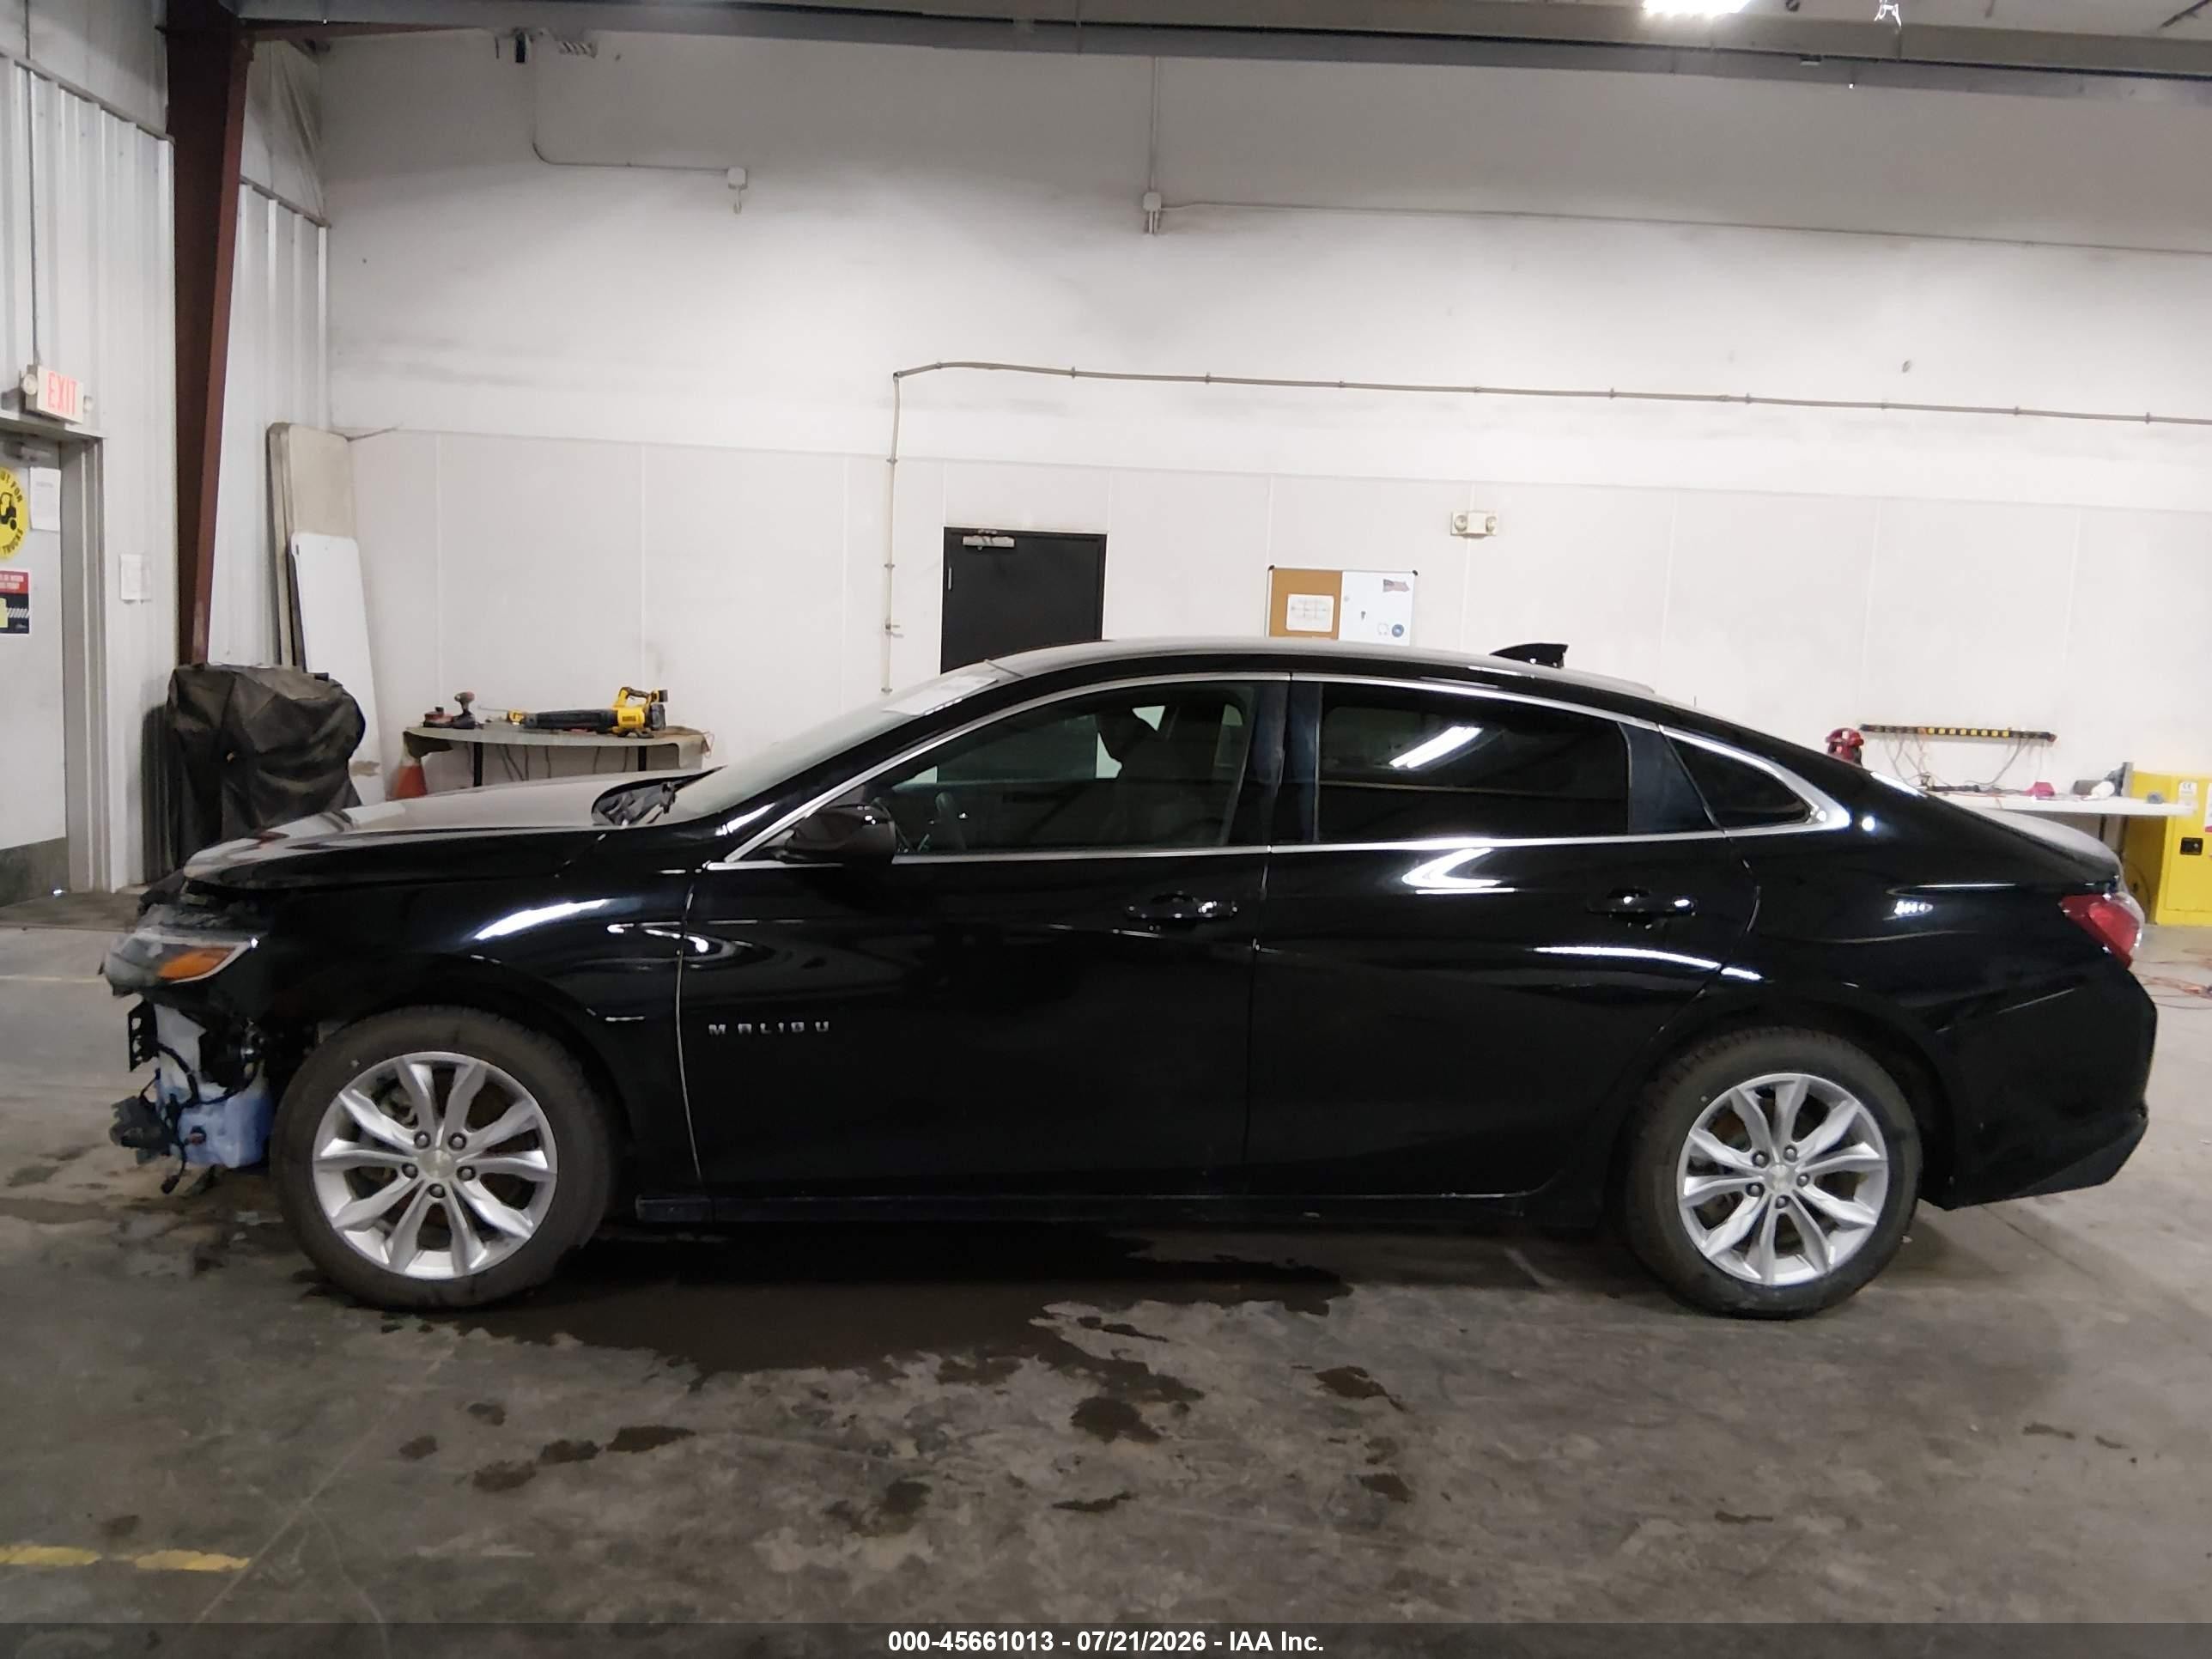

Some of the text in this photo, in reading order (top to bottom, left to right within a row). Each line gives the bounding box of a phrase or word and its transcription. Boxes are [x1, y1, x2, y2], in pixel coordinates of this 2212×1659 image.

[48, 371, 77, 416] EXIT
[10, 480, 23, 503] FOR
[3, 527, 23, 556] TRUCKS
[708, 1021, 830, 1035] MALIBU
